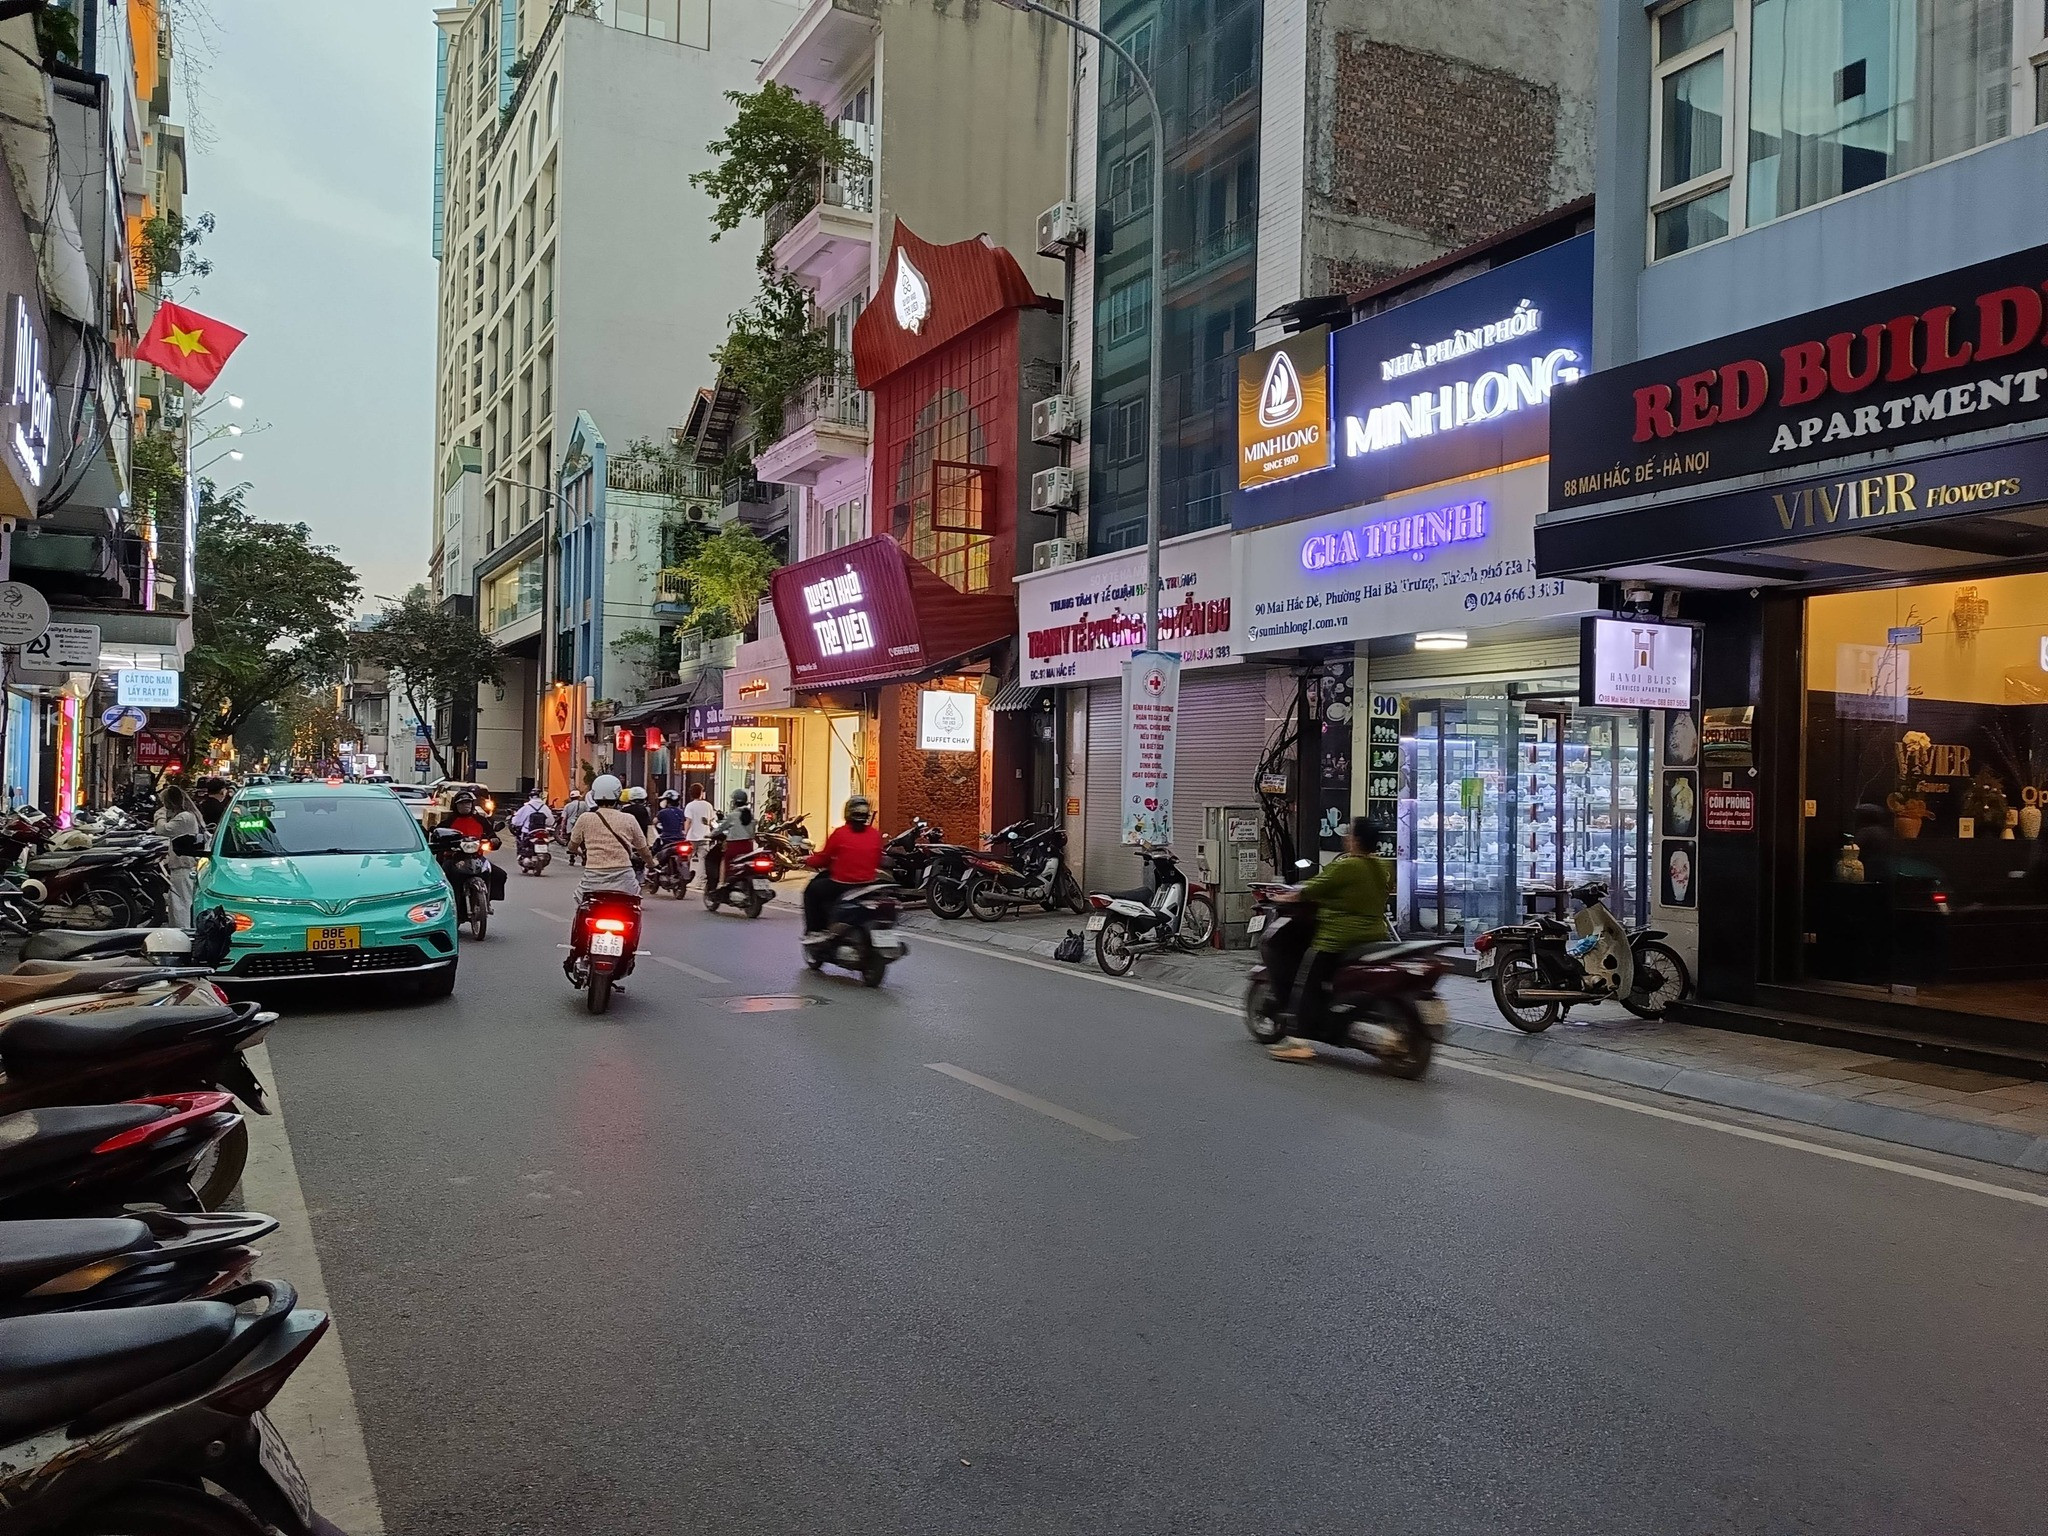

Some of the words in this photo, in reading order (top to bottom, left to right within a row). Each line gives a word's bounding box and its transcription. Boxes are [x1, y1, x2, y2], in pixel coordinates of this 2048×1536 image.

[1382, 342, 1425, 382] NHÀ
[1425, 328, 1484, 367] PHÂN
[1484, 298, 1541, 346] PHỐI
[1632, 358, 1769, 443] RED
[1779, 281, 2048, 408] BUILD
[1346, 386, 1454, 458] MINH
[1455, 348, 1581, 427] LONG
[1768, 367, 2048, 454] APARTMENT
[1244, 436, 1281, 464] MINH
[1281, 425, 1319, 452] LONG
[1263, 458, 1283, 472] SINCE
[1284, 454, 1299, 467] 1970
[1564, 480, 1578, 497] 88
[1578, 474, 1601, 495] MAI
[1603, 461, 1631, 490] HẮC
[1635, 454, 1657, 483] ĐẾ
[1663, 452, 1682, 477] HÀ
[1685, 450, 1710, 475] NỘI
[1771, 472, 1917, 530] VIVIER
[1926, 477, 2021, 509] Flowers
[1301, 529, 1361, 571] GIA
[1362, 499, 1487, 563] THỊNH
[1255, 603, 1266, 616] 90
[1267, 602, 1285, 615] Mai
[1286, 596, 1304, 611] Hắc
[1325, 589, 1361, 605] Phường
[1363, 584, 1382, 599] Hai
[1384, 581, 1398, 595] Bà
[1480, 559, 1503, 584] phố
[1504, 558, 1523, 576] Hà
[1093, 591, 1100, 604] Y
[17, 612, 34, 620] SPA
[156, 676, 173, 685] NAM
[1610, 672, 1641, 683] HANOI
[1647, 674, 1678, 686] BLISS
[1615, 684, 1640, 692] SERVICED
[1642, 686, 1671, 694] APARTMENT
[1373, 695, 1398, 717] 90
[750, 732, 763, 742] 94
[926, 736, 951, 744] BUFFET
[951, 737, 971, 745] CHAY
[1709, 793, 1725, 809] CÒN
[1725, 793, 1751, 809] PHÒNG
[240, 820, 264, 829] TAXI
[322, 929, 346, 938] 88E
[312, 939, 355, 950] 008.51
